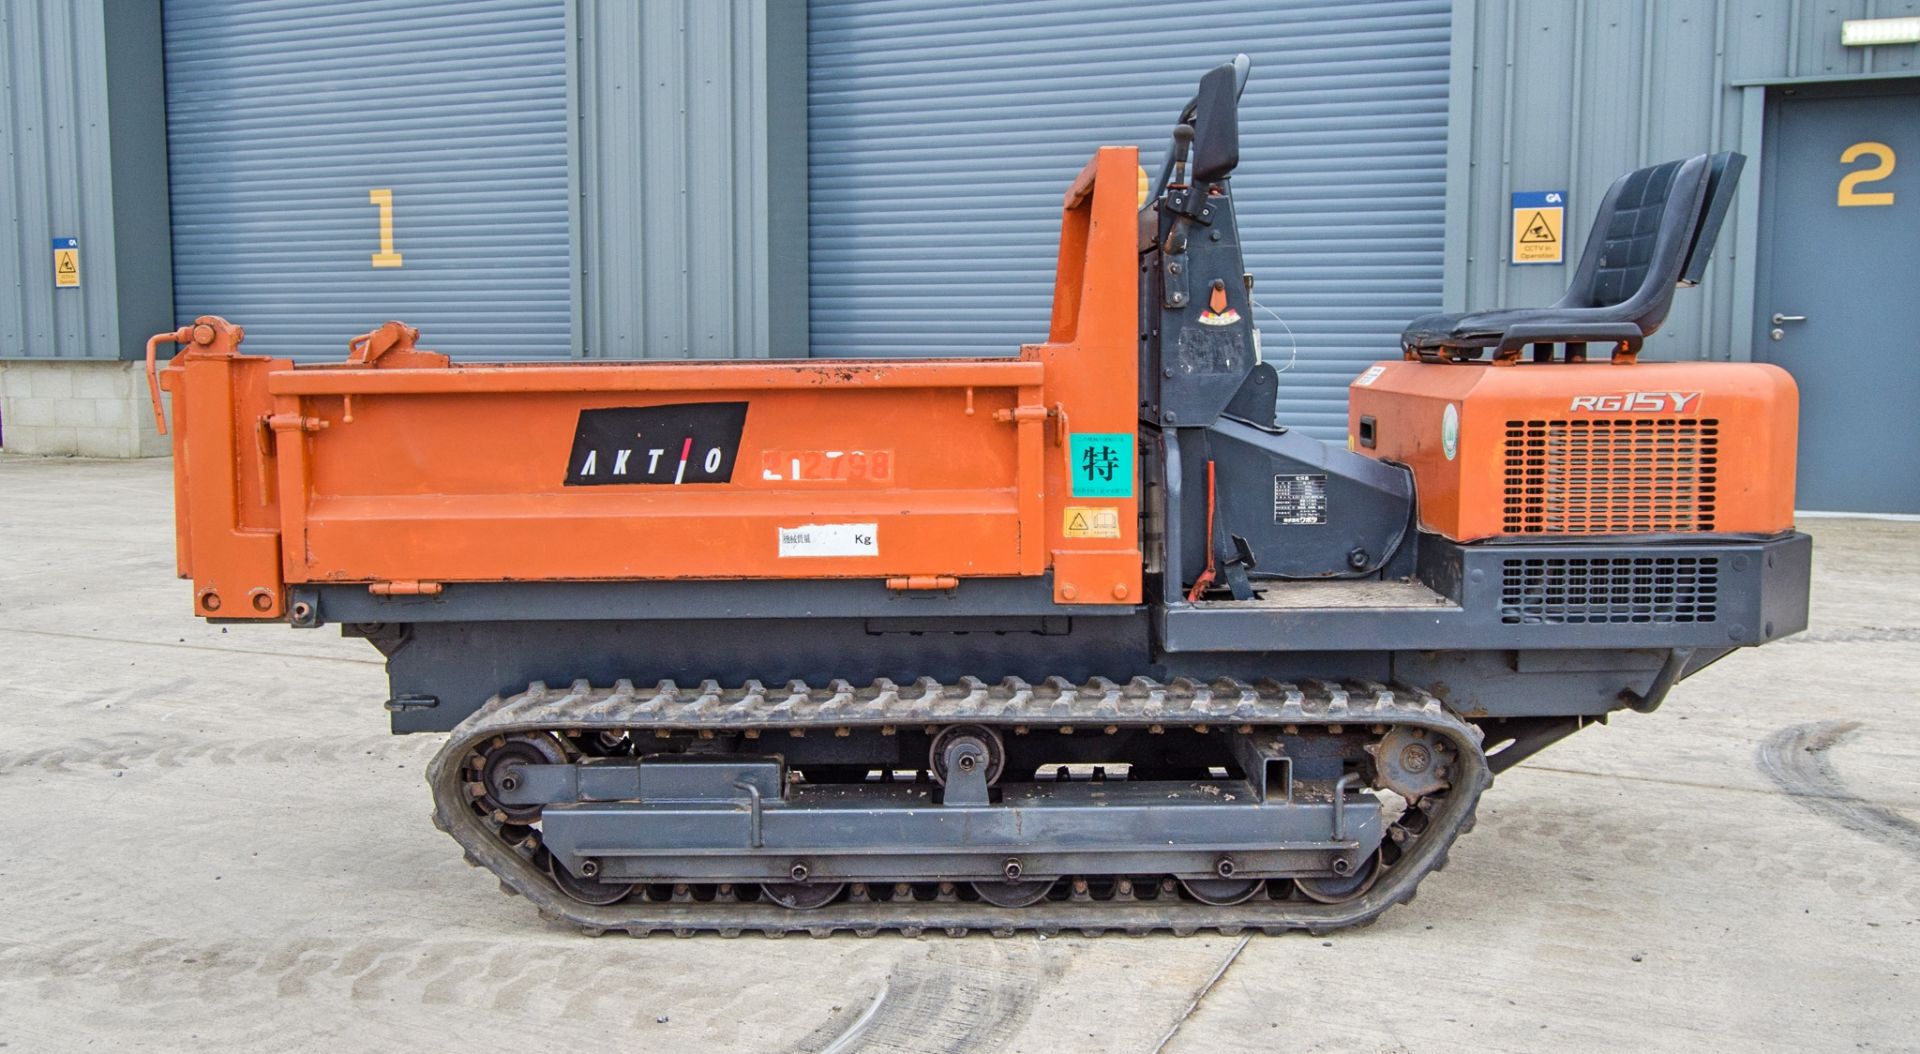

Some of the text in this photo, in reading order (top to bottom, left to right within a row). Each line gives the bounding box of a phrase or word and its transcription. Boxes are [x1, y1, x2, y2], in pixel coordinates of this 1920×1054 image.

[1838, 142, 1896, 206] 2
[1545, 193, 1562, 203] GA
[368, 188, 403, 267] 1
[1569, 392, 1699, 412] RG15Y
[580, 438, 722, 485] AKTIO
[1082, 446, 1120, 481] 特
[855, 534, 872, 545] Kg
